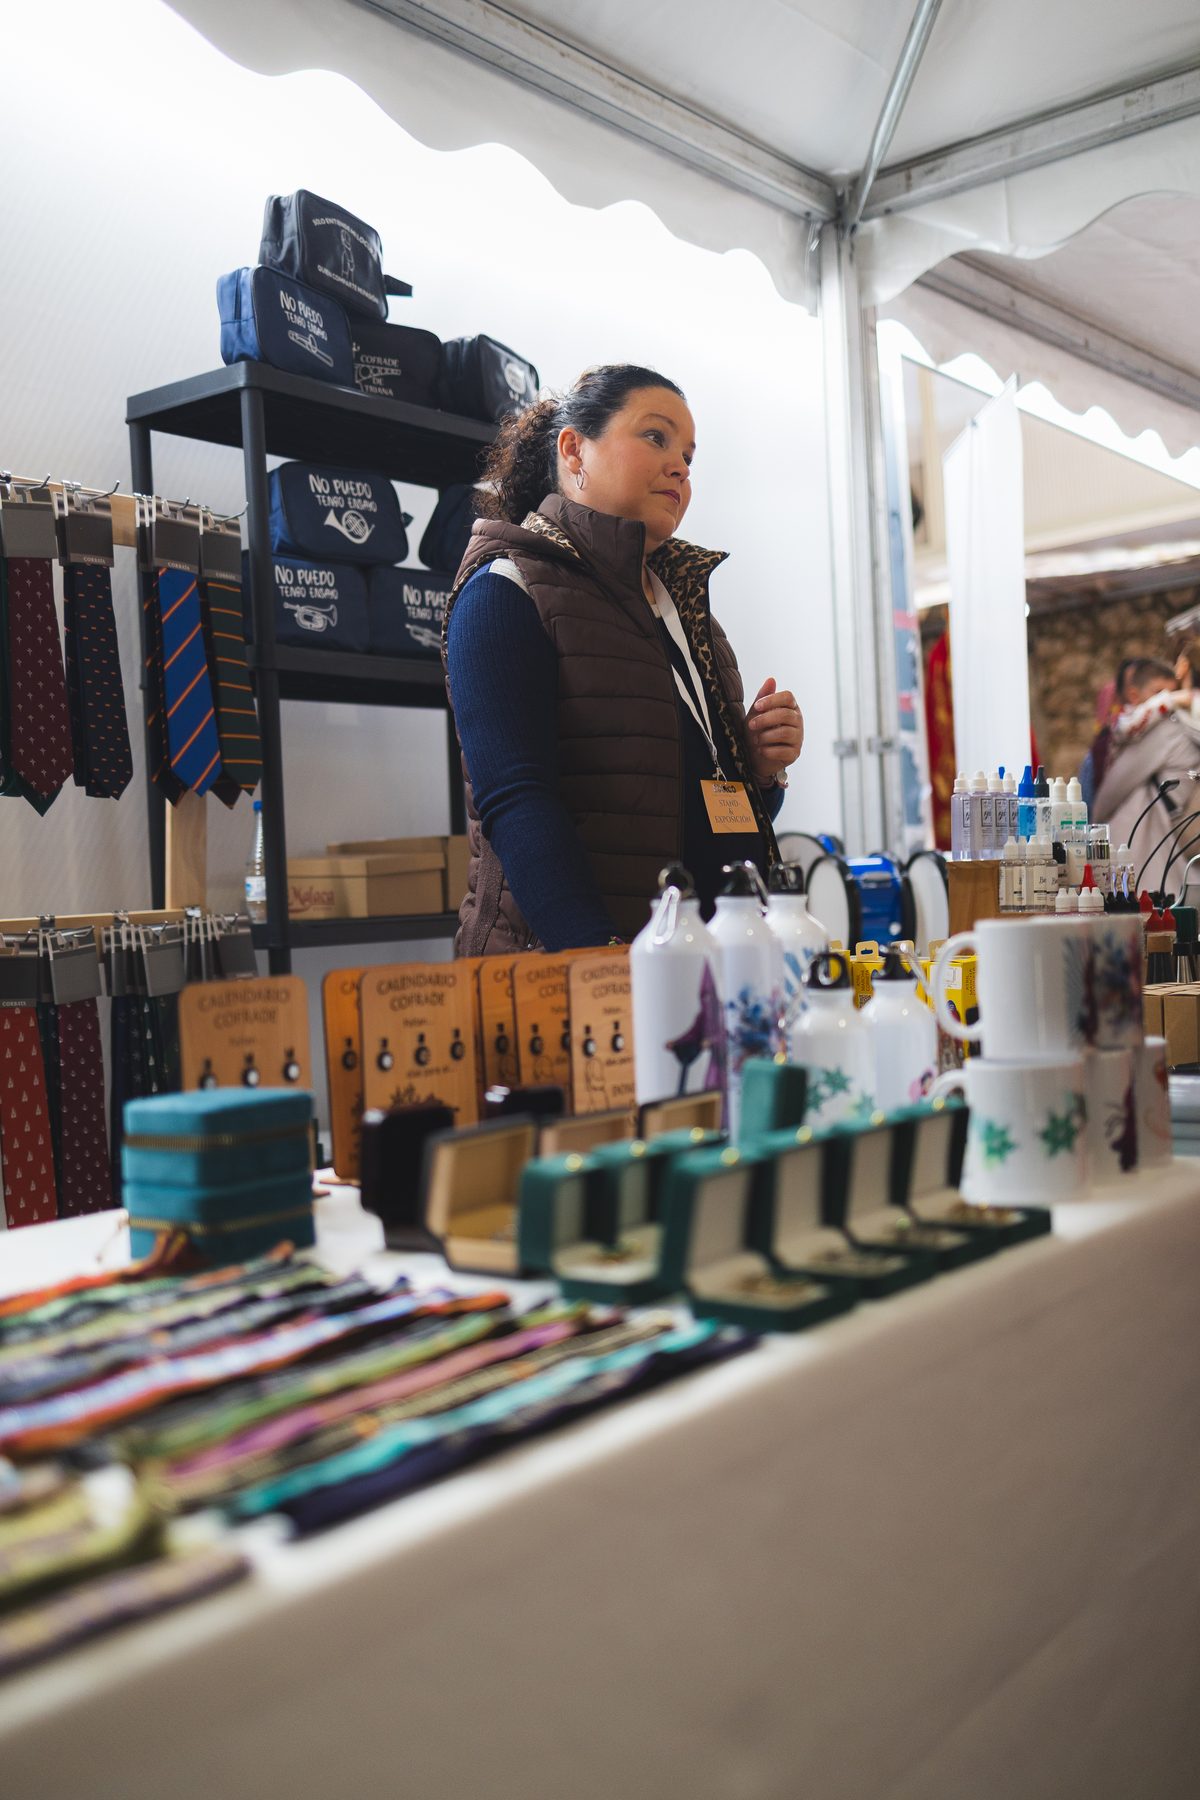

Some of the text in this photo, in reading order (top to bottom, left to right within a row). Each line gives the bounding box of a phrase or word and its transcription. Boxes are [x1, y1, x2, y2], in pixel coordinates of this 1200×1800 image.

[280, 290, 324, 328] NO PUEDO
[360, 355, 400, 368] COFRADE
[364, 384, 394, 397] TRIANA
[309, 474, 373, 499] NO PUEDO
[315, 494, 378, 513] TENGO ENSAYO
[275, 564, 335, 588] NO PUEDO
[278, 585, 339, 600] TENGO ENSAYO
[403, 584, 453, 609] NO PUE
[377, 972, 457, 996] CALENDARIO
[198, 987, 291, 1013] CALENDARIO
[389, 991, 445, 1011] COFRADE
[213, 1006, 278, 1030] COFRADE
